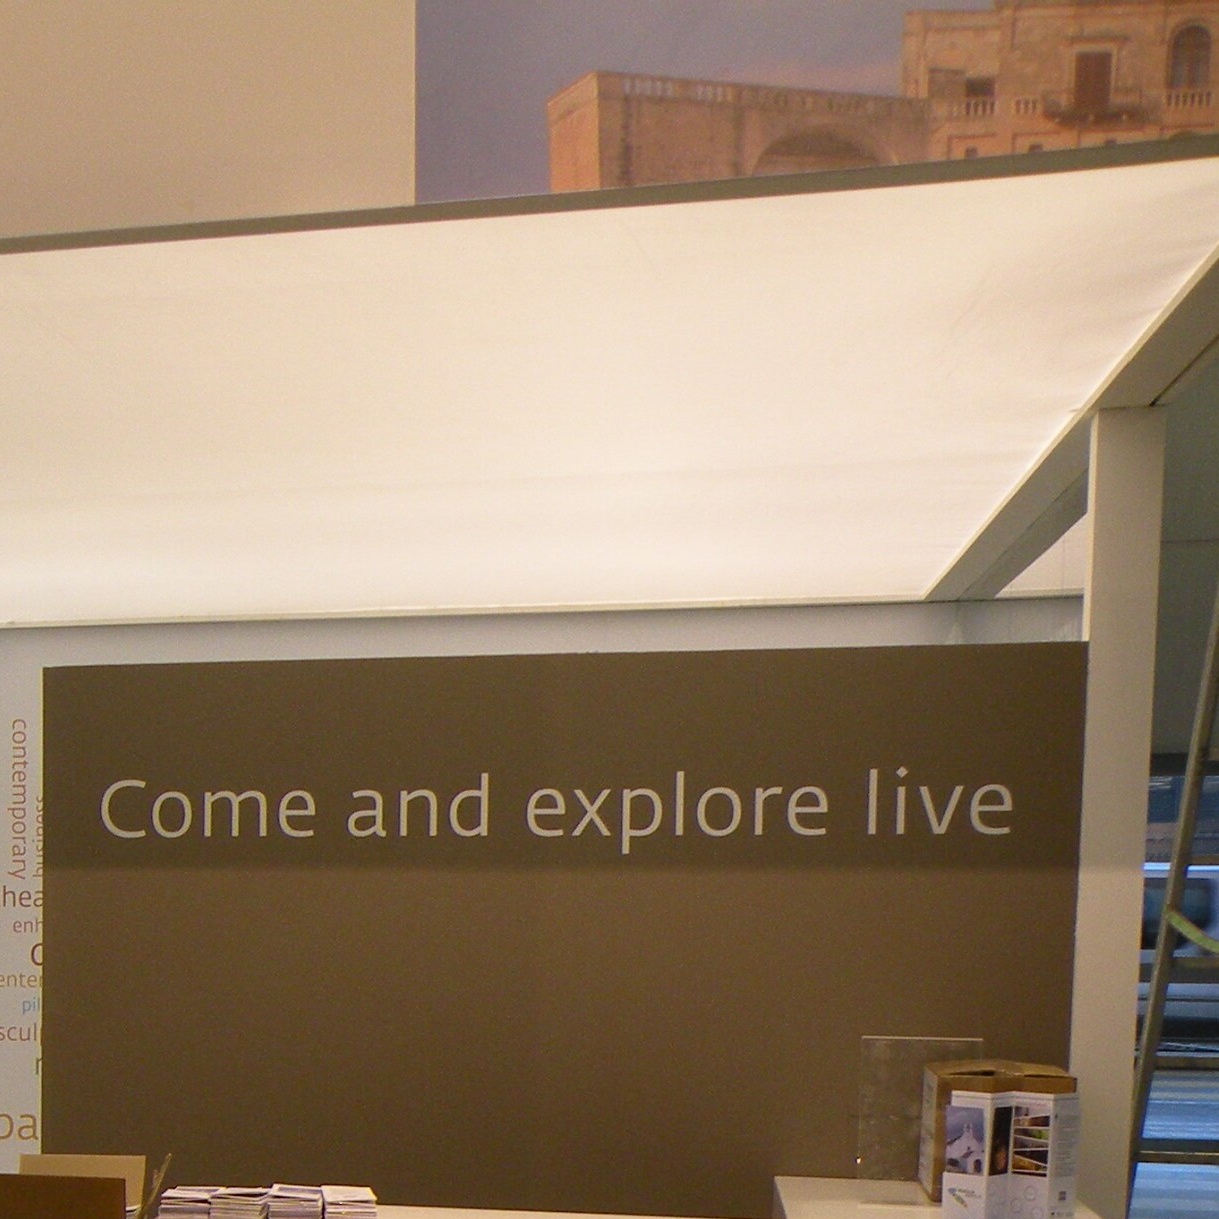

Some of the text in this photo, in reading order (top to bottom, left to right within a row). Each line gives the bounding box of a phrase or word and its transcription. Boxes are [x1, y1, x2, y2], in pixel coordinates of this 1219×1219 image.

[7, 719, 28, 880] contemporary
[100, 767, 1015, 855] Come and explore live
